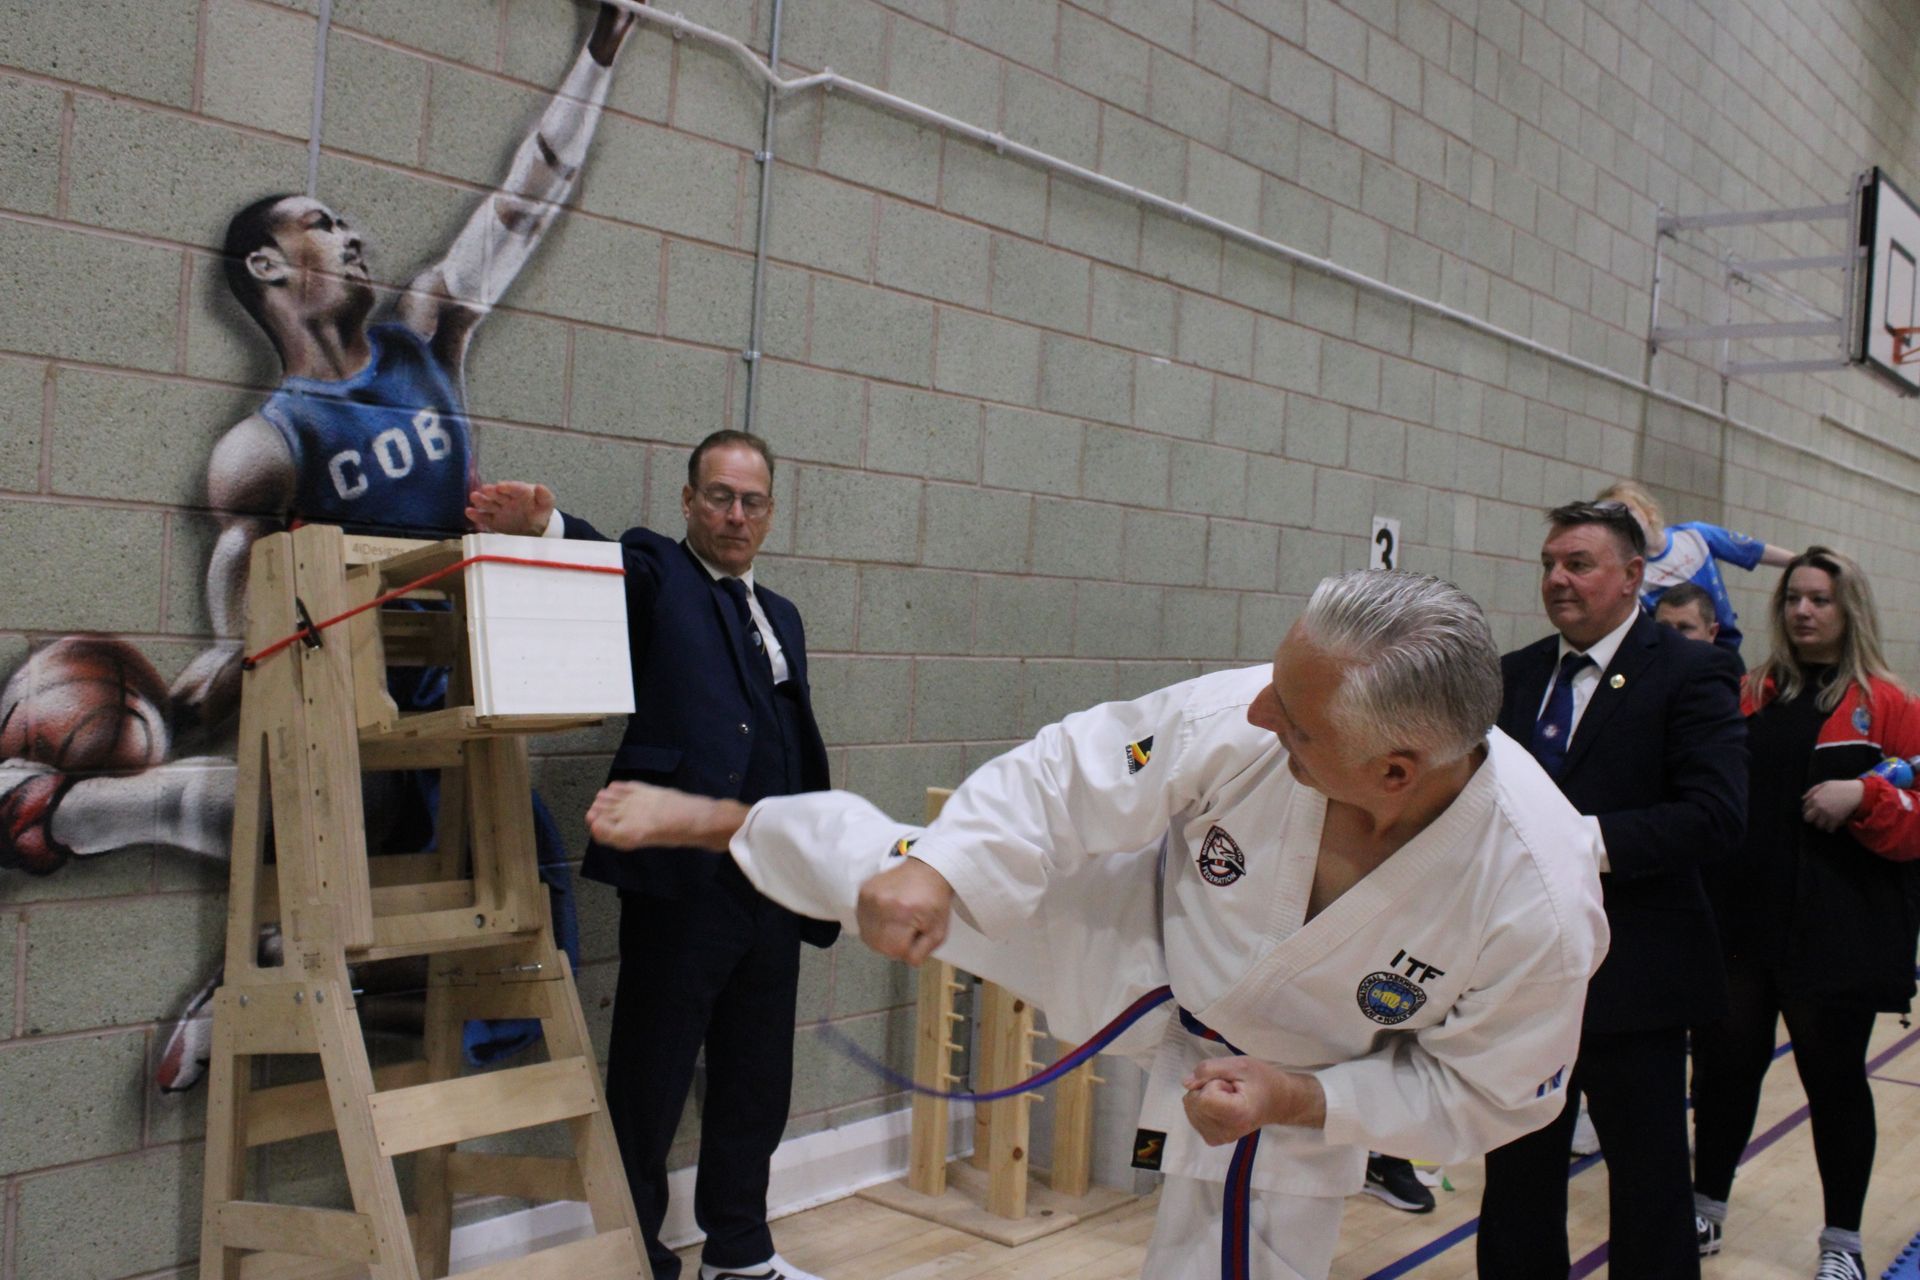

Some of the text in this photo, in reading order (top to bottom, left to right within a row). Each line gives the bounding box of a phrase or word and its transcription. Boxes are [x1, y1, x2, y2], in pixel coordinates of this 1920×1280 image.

[328, 407, 451, 500] COB
[1203, 866, 1237, 884] FEDERATION
[1390, 949, 1445, 983] ITF
